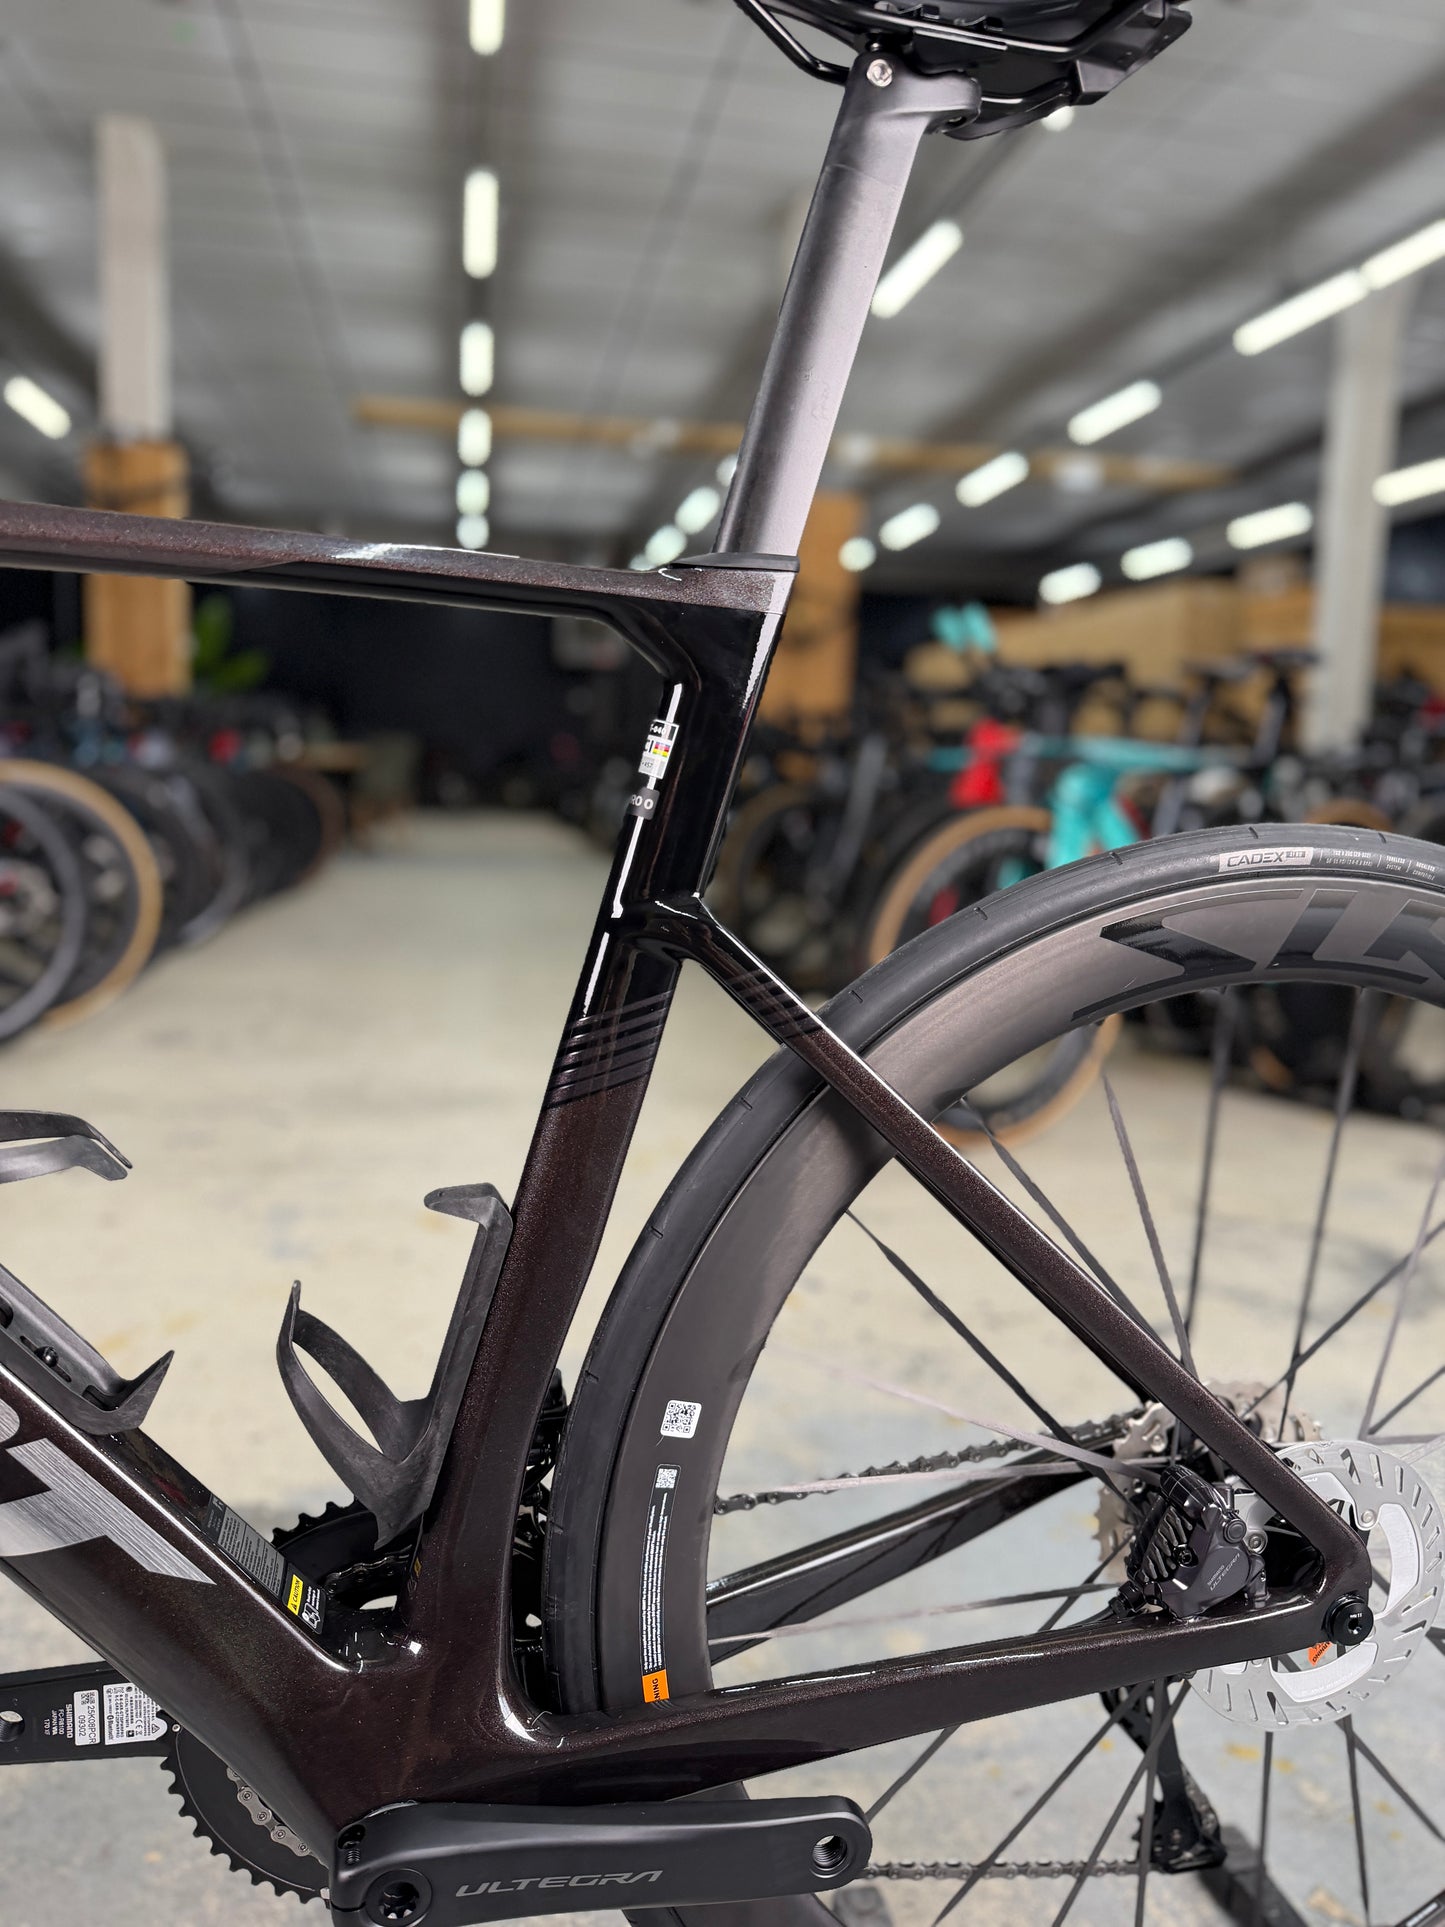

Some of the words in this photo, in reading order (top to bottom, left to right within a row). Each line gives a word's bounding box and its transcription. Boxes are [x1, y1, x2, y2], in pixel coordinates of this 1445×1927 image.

[1227, 851, 1285, 867] CADEX
[1210, 1553, 1240, 1591] ULTEGRA
[292, 1579, 301, 1603] CAUTION
[65, 1703, 74, 1739] SHIMANO
[78, 1714, 87, 1737] 09302
[87, 1705, 97, 1744] 25K08PCR
[456, 1869, 664, 1897] ULTEGRA
